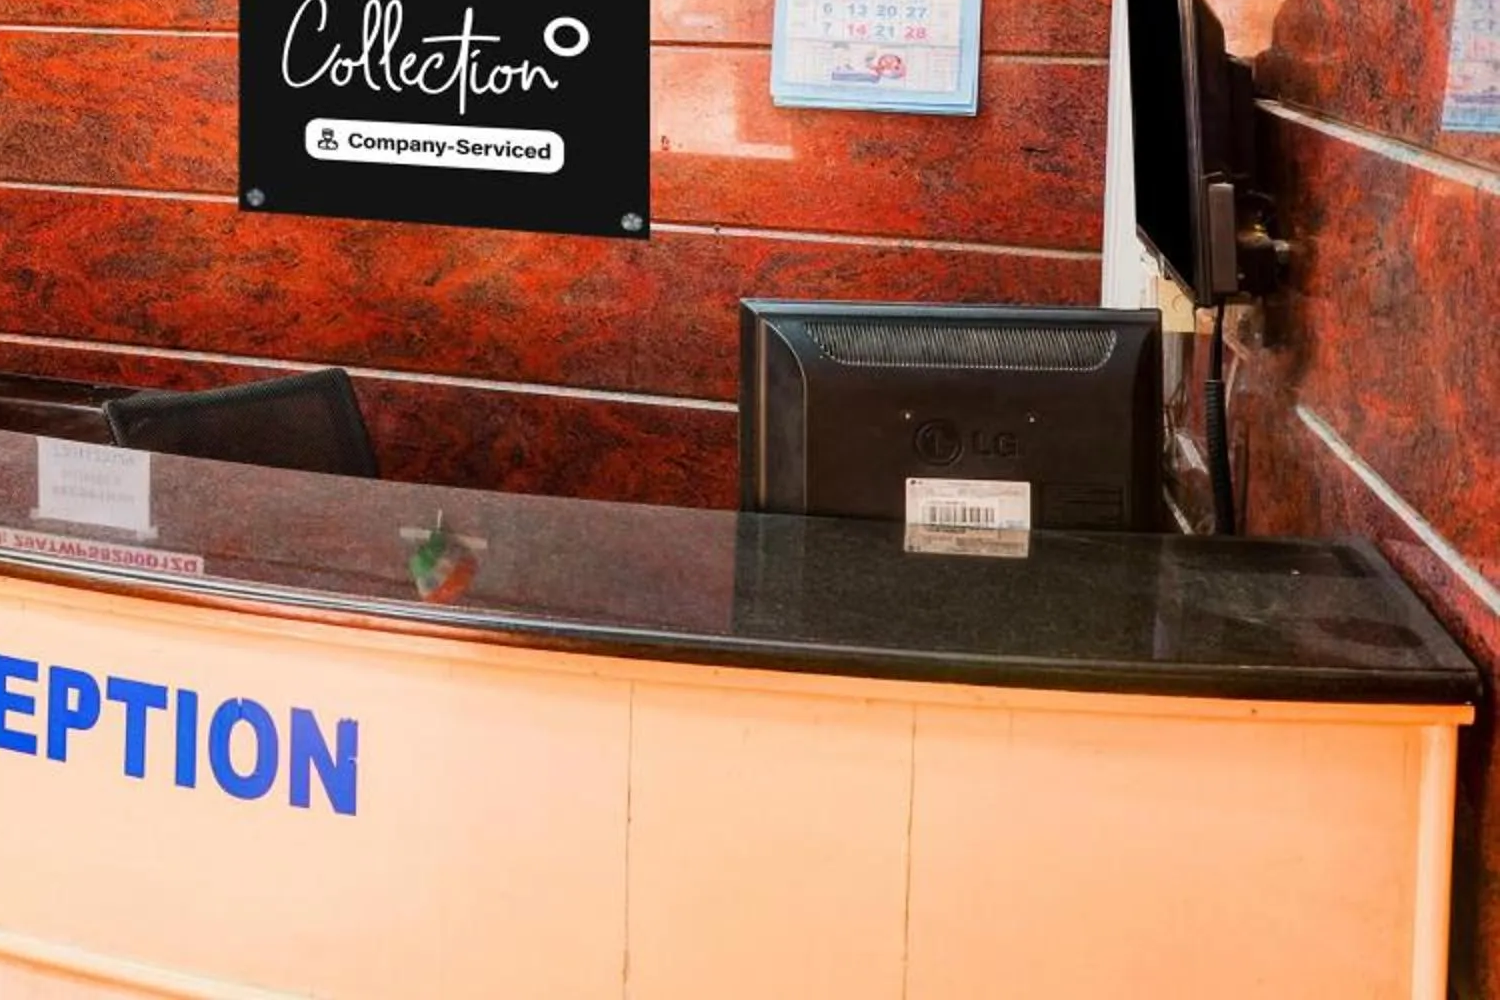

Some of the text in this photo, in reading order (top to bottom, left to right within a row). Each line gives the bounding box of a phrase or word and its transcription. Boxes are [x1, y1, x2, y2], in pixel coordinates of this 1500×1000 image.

[876, 5, 897, 18] 20
[906, 7, 927, 19] 27
[847, 24, 867, 36] 14
[876, 25, 895, 38] 21
[904, 27, 927, 39] 28
[348, 132, 551, 160] Company-Serviced
[972, 431, 1020, 458] LG
